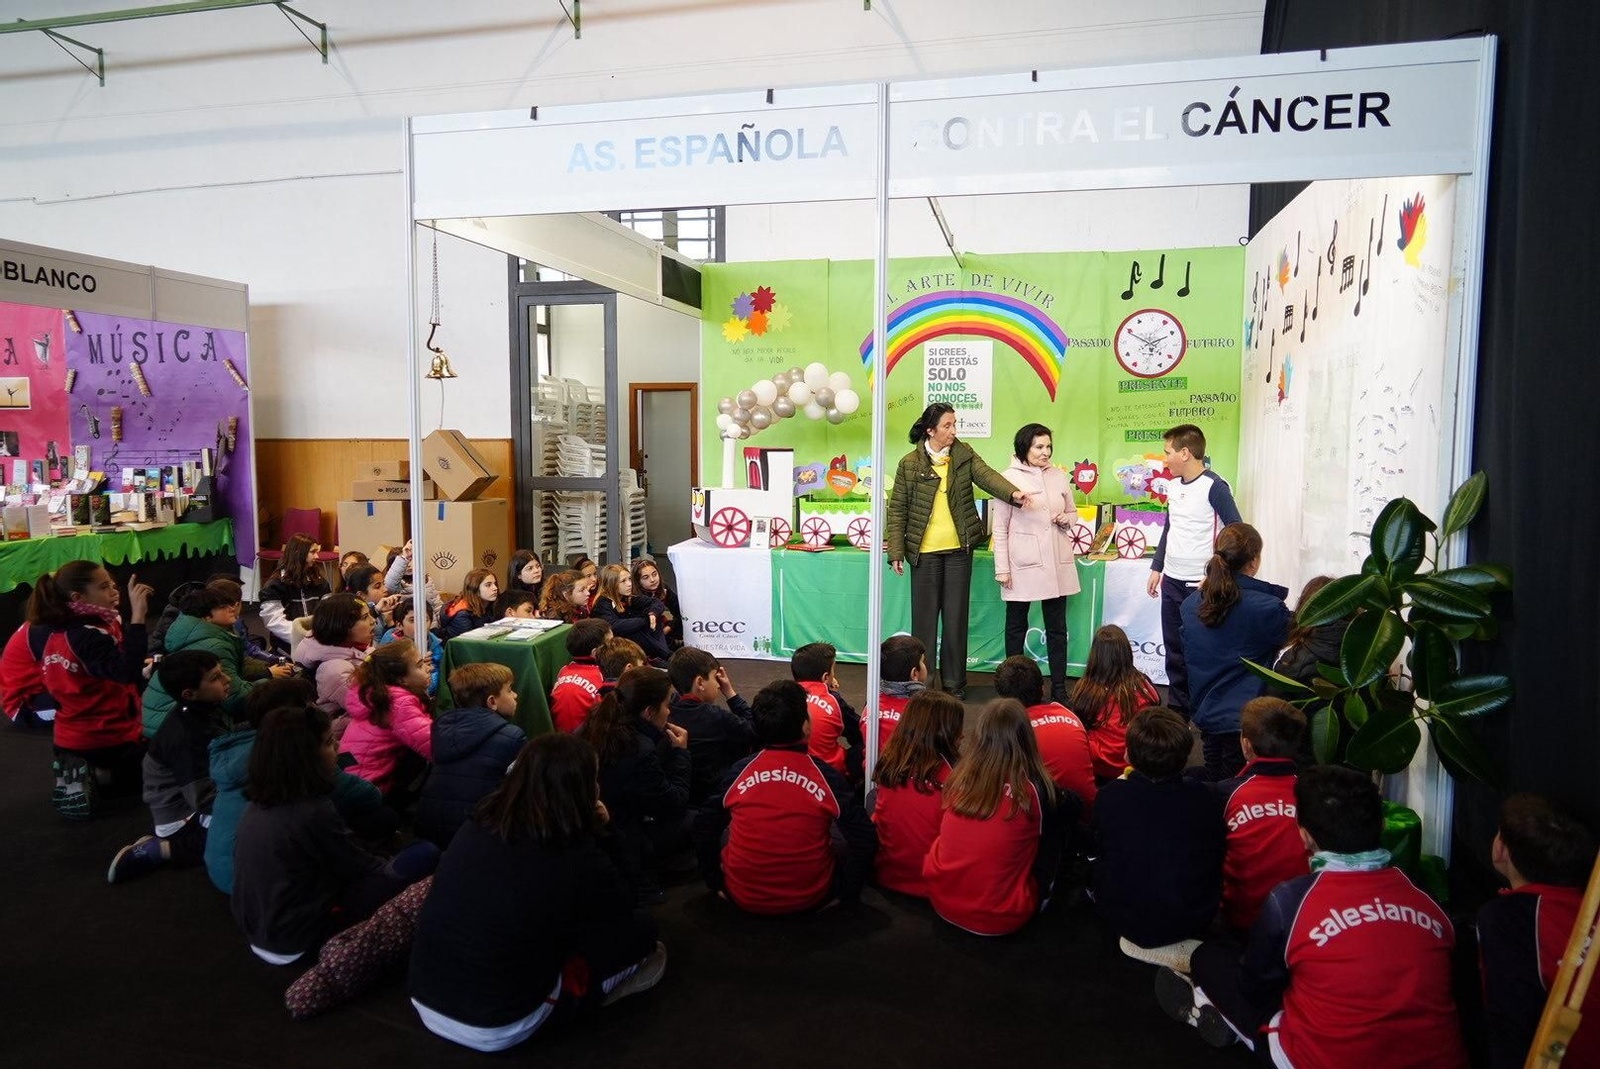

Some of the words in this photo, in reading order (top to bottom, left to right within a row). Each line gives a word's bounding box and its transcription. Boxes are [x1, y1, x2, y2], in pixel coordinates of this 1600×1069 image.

[566, 140, 626, 174] AS.
[634, 123, 850, 170] ESPAÑOLA
[1113, 105, 1170, 142] EL
[1180, 85, 1392, 138] CÁNCER
[906, 273, 955, 293] ARTE
[971, 273, 993, 288] DE
[1002, 276, 1055, 309] VIVIR
[87, 323, 218, 365] MÚSICA
[1067, 337, 1112, 349] PASADO
[1186, 338, 1235, 349] FUTURO
[928, 347, 938, 356] SI
[938, 347, 967, 356] CREES
[928, 357, 947, 366] QUE
[948, 354, 979, 366] ESTÁS
[927, 367, 967, 381] SOLO
[927, 382, 943, 392] NO
[944, 382, 966, 392] NOS
[1120, 379, 1184, 391] PRESENTE
[927, 393, 978, 403] CONOCES
[1190, 392, 1238, 404] PASADO
[691, 619, 747, 634] aecc
[730, 644, 747, 652] VIDA
[1129, 639, 1166, 657] ecc
[1030, 714, 1079, 728] esianos
[736, 765, 827, 803] salesianos
[1227, 799, 1297, 832] salesia
[1308, 897, 1443, 948] salesianos
